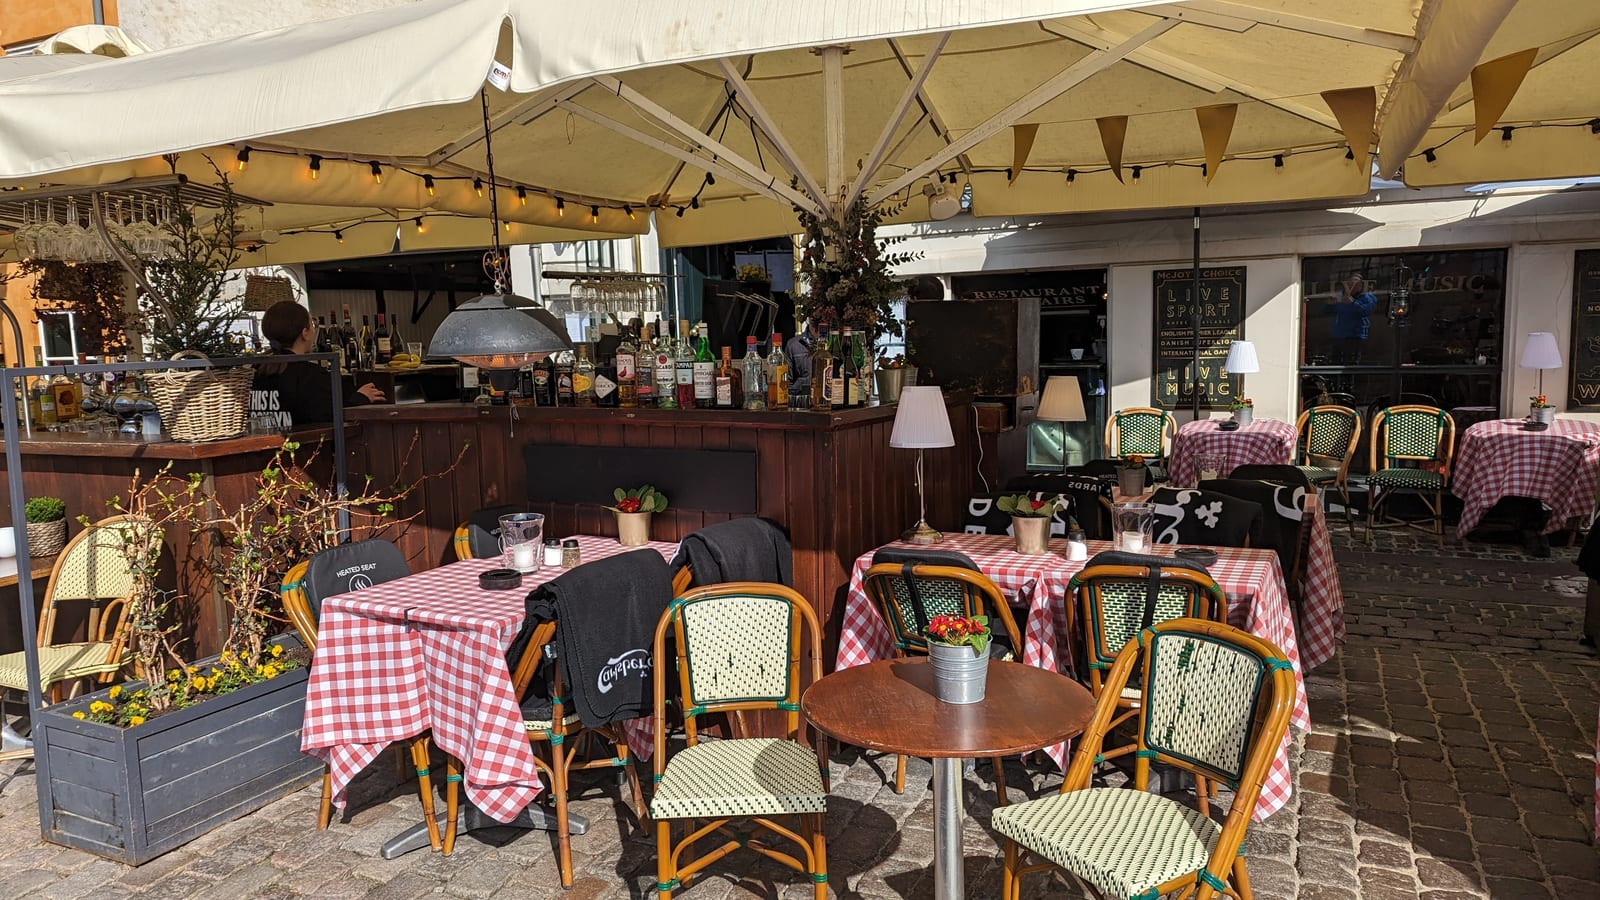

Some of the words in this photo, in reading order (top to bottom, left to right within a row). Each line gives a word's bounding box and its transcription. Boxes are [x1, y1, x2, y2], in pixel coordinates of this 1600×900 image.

[973, 286, 1099, 298] RESTAURANT
[1168, 287, 1229, 301] LIVE
[1311, 279, 1377, 297] LIVE
[1040, 296, 1085, 305] AIRS
[1166, 303, 1230, 317] SPORT
[1212, 328, 1237, 336] LEAGUE
[1167, 366, 1229, 380] LIVE
[1166, 382, 1230, 396] MUSIC
[269, 390, 280, 411] IS
[336, 566, 361, 578] HEATED
[361, 562, 377, 571] SEAT
